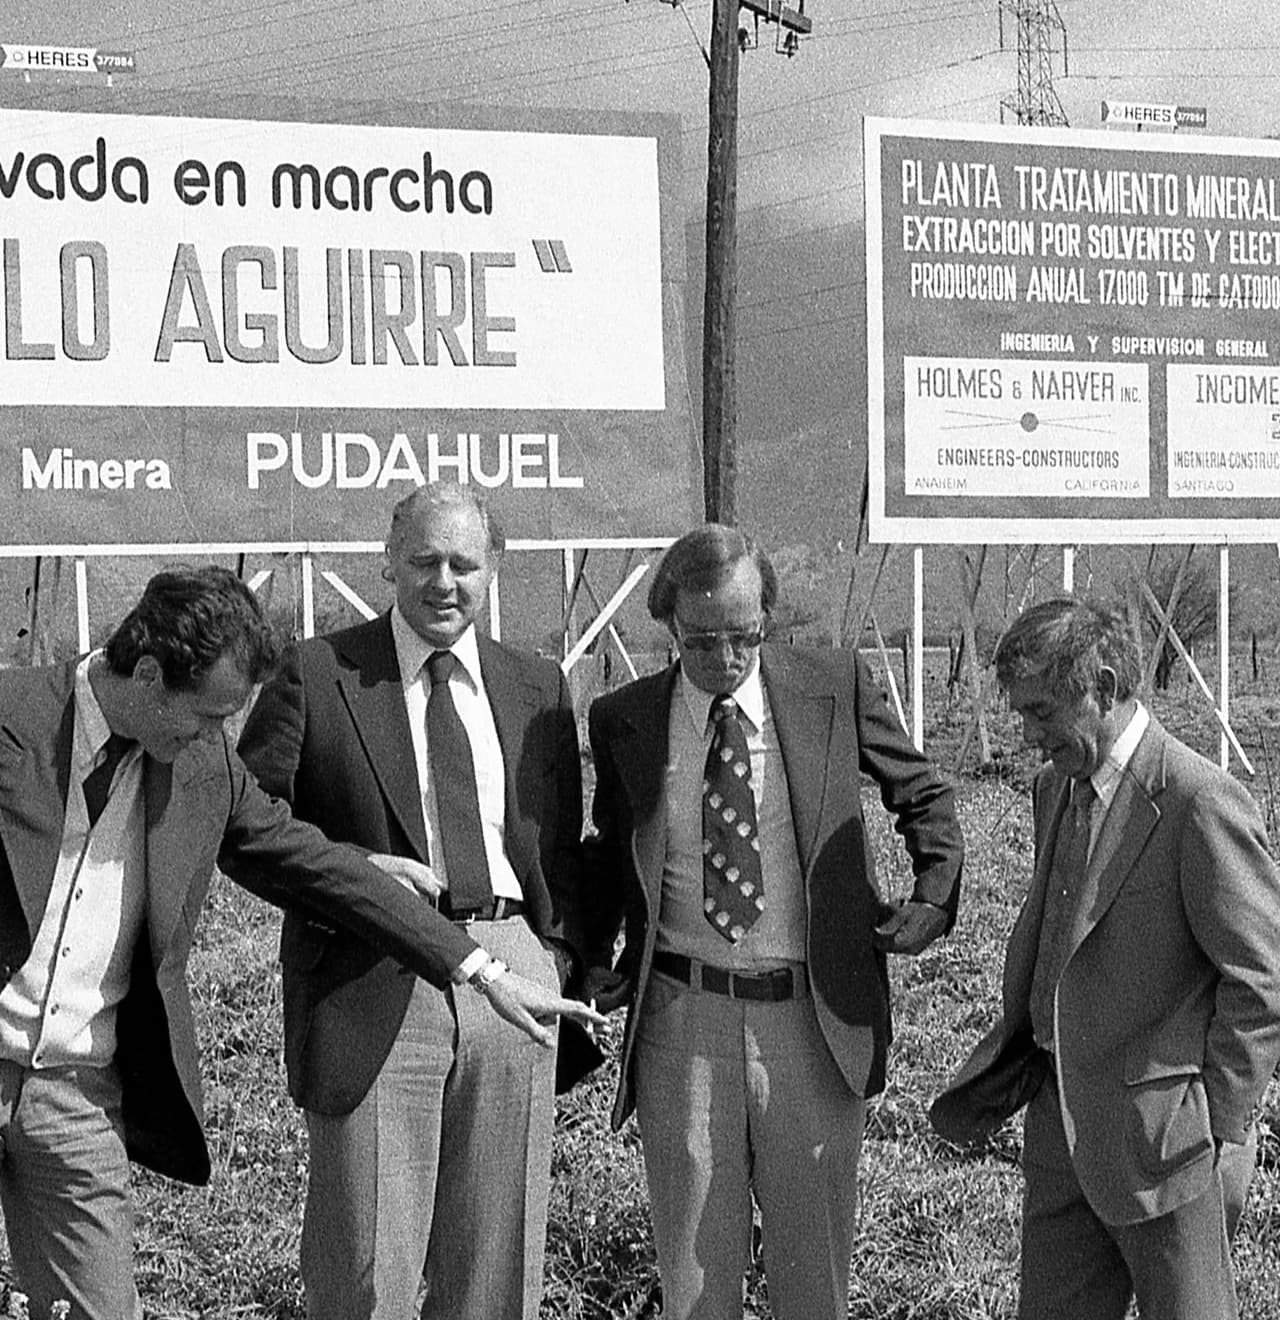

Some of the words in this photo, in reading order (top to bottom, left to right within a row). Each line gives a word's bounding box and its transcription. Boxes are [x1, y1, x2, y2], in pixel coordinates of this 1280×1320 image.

[27, 50, 89, 67] HERES
[1124, 105, 1172, 122] HERES
[174, 160, 246, 206] en
[272, 151, 493, 215] marcha
[902, 159, 1002, 209] PLANTA
[1014, 165, 1179, 218] TRATAMIENTO
[903, 215, 1035, 257] EXTRACCION
[1040, 221, 1081, 258] POR
[1087, 224, 1196, 263] SOLVENTES
[1204, 229, 1222, 263] Y
[911, 262, 1017, 302] PRODUCCION
[1026, 267, 1091, 304] ANUAL
[1098, 269, 1150, 307] 17.000
[1157, 272, 1184, 308] TM
[1191, 273, 1211, 308] DE
[1000, 332, 1075, 353] INGENIERIA
[1087, 335, 1099, 354] Y
[1112, 337, 1204, 357] SUPERVISION
[1216, 339, 1269, 358] GENERAL
[917, 367, 1003, 400] HOLMES
[1012, 380, 1023, 400] &
[1031, 370, 1115, 403] NARVER
[1119, 386, 1143, 404] INC.
[22, 448, 171, 491] Minera
[248, 432, 583, 488] PUDAHUEL
[937, 448, 1120, 469] ENGINEERS-CONSTRUCTORS
[915, 478, 967, 489] ANAHEIM
[1064, 479, 1141, 491] CALIFORNIA
[1174, 480, 1234, 492] SANTIAGO
